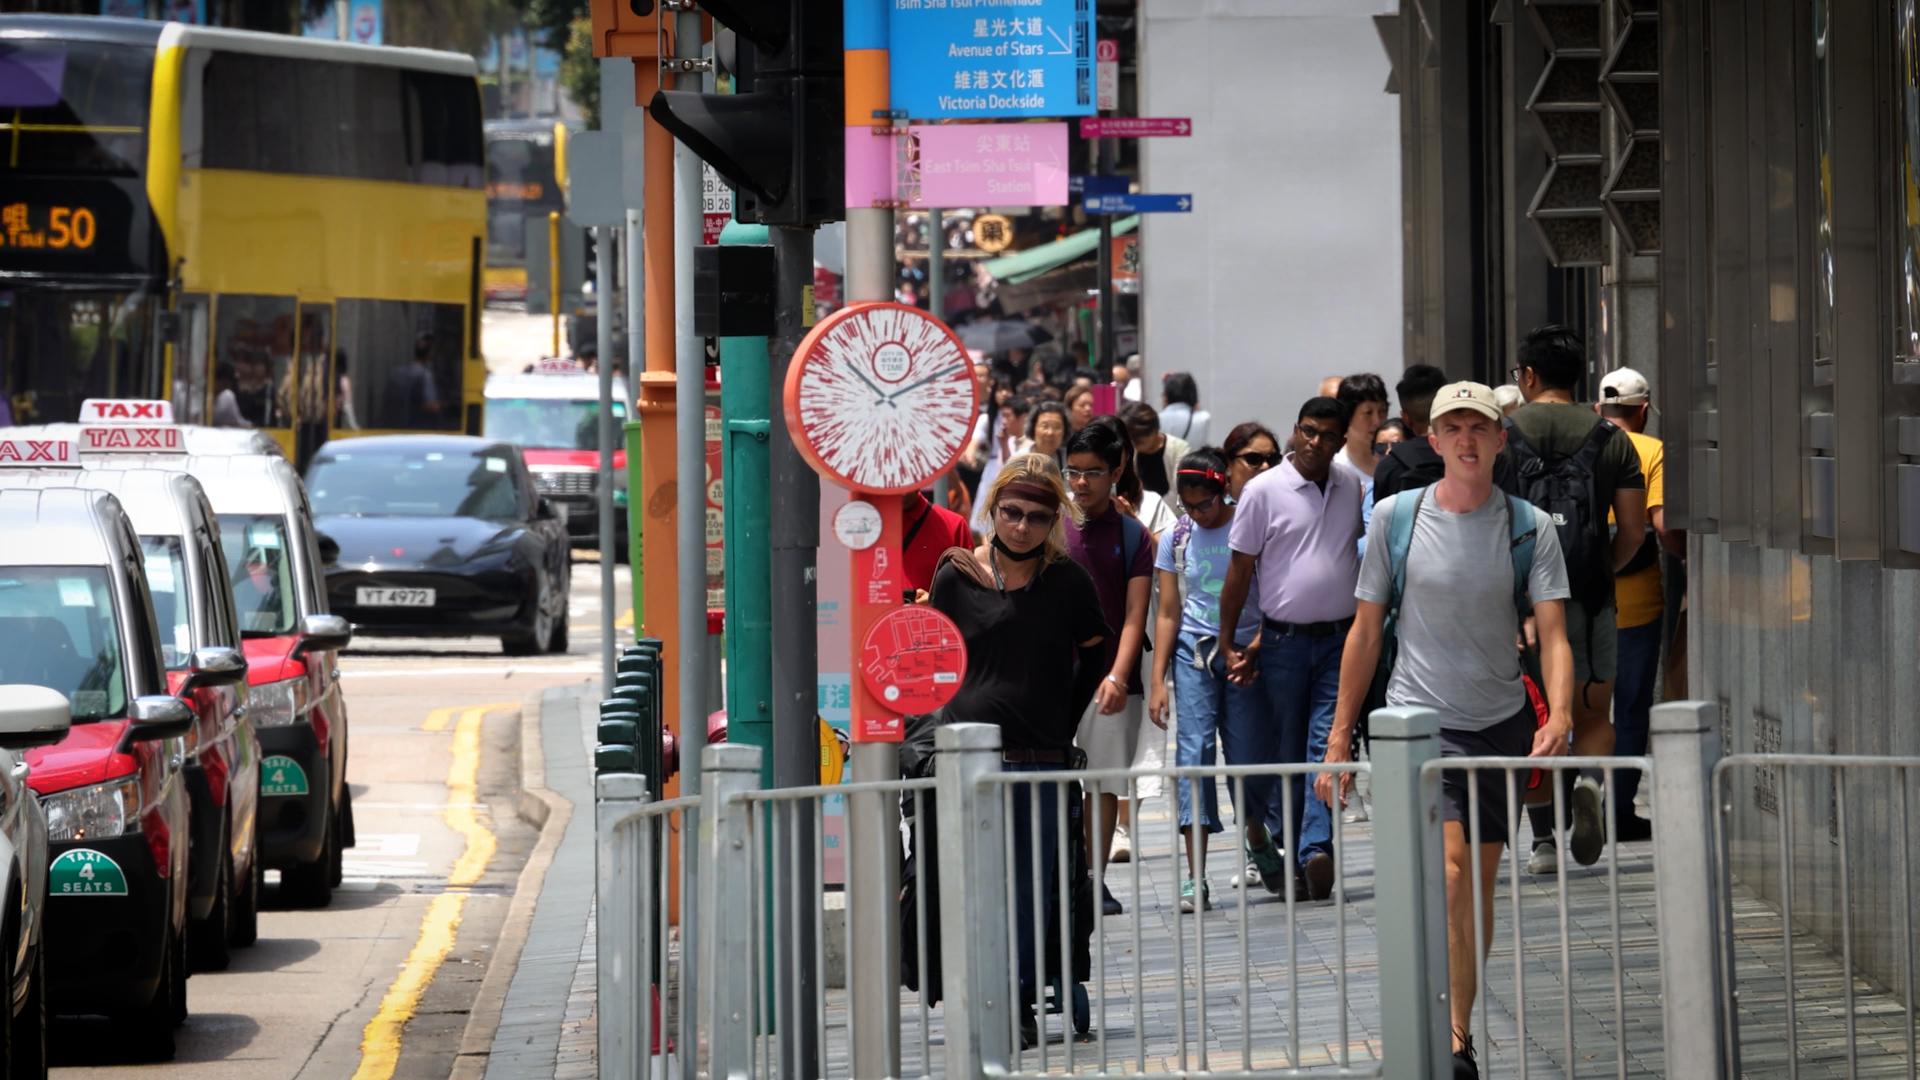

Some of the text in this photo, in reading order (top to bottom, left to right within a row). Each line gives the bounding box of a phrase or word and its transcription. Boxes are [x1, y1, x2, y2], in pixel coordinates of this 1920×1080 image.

[973, 17, 1043, 37] 星光大道
[948, 41, 1044, 57] Avenue of Stars
[939, 94, 1045, 110] Victoria Dockside
[976, 134, 1031, 153] 尖東站
[926, 159, 1032, 173] East Tsim Sha Tsui
[987, 179, 1032, 193] Station
[718, 198, 730, 211] 26
[48, 207, 96, 249] 50
[9, 232, 44, 247] Tsui
[92, 403, 163, 418] TAXI
[86, 428, 177, 447] TAXI
[364, 590, 428, 604] YT 4972
[271, 769, 285, 784] 4
[66, 852, 101, 863] TAXI
[78, 863, 95, 880] 4
[62, 882, 112, 892] SEATS
